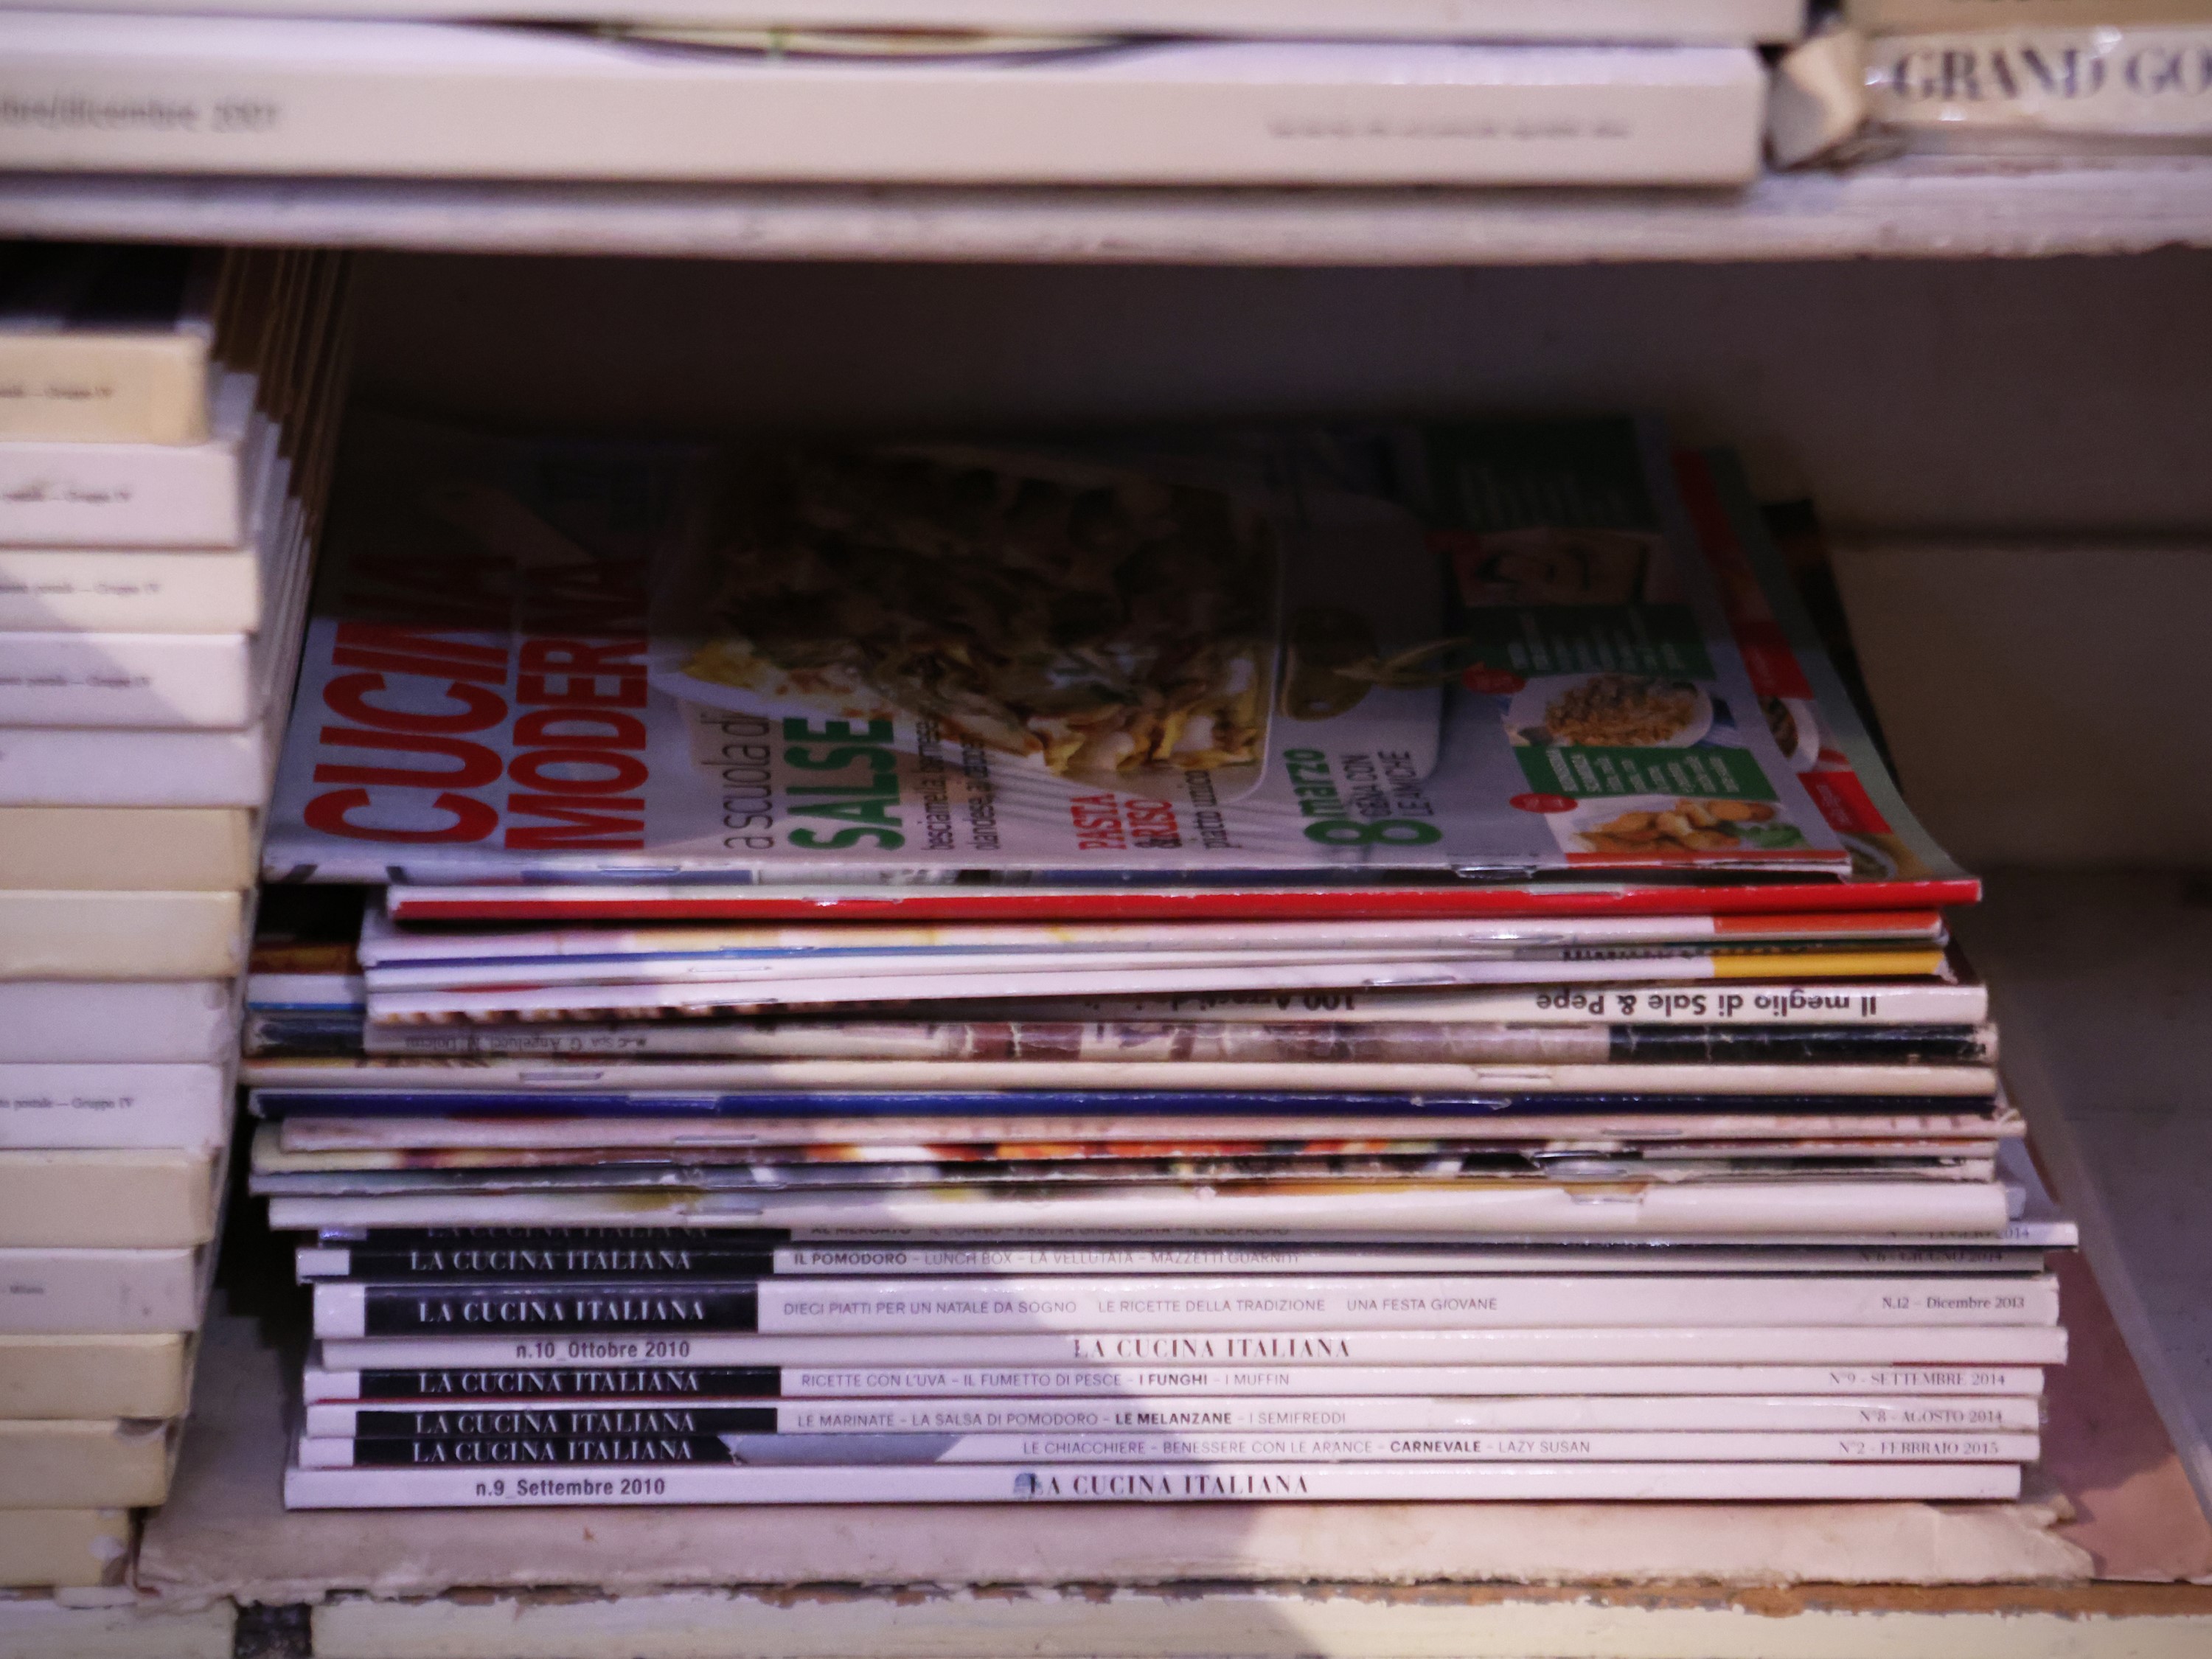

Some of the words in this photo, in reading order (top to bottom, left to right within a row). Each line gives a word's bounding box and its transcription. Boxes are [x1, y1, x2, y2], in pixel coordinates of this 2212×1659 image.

[1891, 49, 2106, 102] GRAND
[304, 554, 515, 844] CUCINA
[504, 559, 649, 850] MODERNA
[1341, 754, 1378, 782] CON
[700, 742, 773, 830] scuola
[783, 717, 906, 852] SALSE
[1283, 748, 1349, 818] marzo
[1070, 793, 1127, 851] PASTA
[723, 835, 774, 849] a
[1304, 819, 1443, 846] 8
[1536, 989, 1605, 1016] Pepe
[1618, 995, 1638, 1015] &
[1649, 995, 1707, 1017] Sale
[1719, 996, 1743, 1017] di
[1755, 990, 1851, 1017] meglio
[1863, 998, 1877, 1016] Il
[411, 1251, 443, 1270] LA
[453, 1251, 554, 1270] CUCINA
[568, 1251, 692, 1270] ITALIANA
[794, 1253, 808, 1265] IL
[812, 1253, 908, 1265] POMODORO
[924, 1252, 976, 1265] LUNCH
[982, 1252, 1012, 1265] BOX
[1031, 1253, 1048, 1265] LA
[1053, 1252, 1134, 1265] VELLUTATA
[1150, 1251, 1224, 1264] MAZZETTI
[419, 1303, 452, 1322] LA
[463, 1302, 565, 1322] CUCINA
[576, 1300, 706, 1321] ITALIANA
[784, 1303, 824, 1315] DIECI
[829, 1302, 872, 1315] PIATTI
[876, 1302, 905, 1315] PER
[910, 1302, 932, 1314] UN
[936, 1301, 989, 1314] NATALE
[995, 1301, 1014, 1313] DA
[1018, 1301, 1077, 1313] SOGNO
[1098, 1301, 1115, 1312] LE
[1120, 1301, 1180, 1312] RICETTE
[1186, 1301, 1232, 1312] DELLA
[1237, 1300, 1326, 1312] TRADIZIONE
[1347, 1299, 1378, 1311] UNA
[1382, 1298, 1427, 1311] FESTA
[1430, 1298, 1498, 1310] GIOVANE
[1926, 1297, 1992, 1310] Dicembre
[1994, 1297, 2025, 1310] 2013
[644, 1340, 690, 1358] 2010
[1074, 1339, 1105, 1358] LA
[1116, 1339, 1214, 1357] CUCINA
[1228, 1338, 1350, 1357] ITALIANA
[419, 1374, 452, 1394] LA
[461, 1373, 563, 1393] CUCINA
[574, 1372, 700, 1392] ITALIANA
[801, 1374, 861, 1387] RICETTE
[866, 1374, 901, 1387] CON
[905, 1374, 946, 1386] L'UVA
[963, 1374, 975, 1386] IL
[981, 1374, 1051, 1386] FUMETTO
[1056, 1374, 1069, 1386] DI
[1075, 1374, 1122, 1386] PESCE
[1148, 1374, 1208, 1385] FUNGHI
[1234, 1374, 1290, 1385] MUFFIN
[1871, 1372, 1966, 1385] SETTEMBRE
[1972, 1372, 2006, 1385] 2014
[415, 1414, 450, 1434] LA
[457, 1413, 560, 1433] CUCINA
[571, 1412, 696, 1433] ITALIANA
[798, 1416, 813, 1427] LE
[818, 1415, 894, 1427] MARINATE
[912, 1414, 930, 1427] LA
[935, 1414, 982, 1427] SALSA
[987, 1413, 1001, 1426] DI
[1006, 1413, 1098, 1426] POMODORO
[1115, 1413, 1133, 1425] LE
[1137, 1413, 1232, 1425] MELANZANE
[1258, 1413, 1346, 1425] SEMIFREDDI
[1902, 1411, 1964, 1423] AGOSTO
[1969, 1411, 2003, 1422] 2014
[413, 1443, 446, 1462] LA
[454, 1442, 557, 1461] CUCINA
[568, 1441, 694, 1461] ITALIANA
[1023, 1443, 1039, 1455] LE
[1044, 1442, 1145, 1455] CHIACCHIERE
[1163, 1441, 1246, 1454] BENESSERE
[1252, 1441, 1286, 1453] CON
[1291, 1441, 1306, 1453] LE
[1312, 1441, 1373, 1453] ARANCE
[1390, 1441, 1481, 1453] CARNEVALE
[1498, 1441, 1535, 1453] LAZY
[1540, 1441, 1590, 1453] SUSAN
[1881, 1441, 1959, 1454] FEBBRAIO
[1964, 1441, 1999, 1454] 2015
[620, 1478, 665, 1496] 2010
[1031, 1475, 1060, 1495] LA
[1072, 1475, 1172, 1495] CUCINA
[1184, 1475, 1308, 1494] ITALIANA
